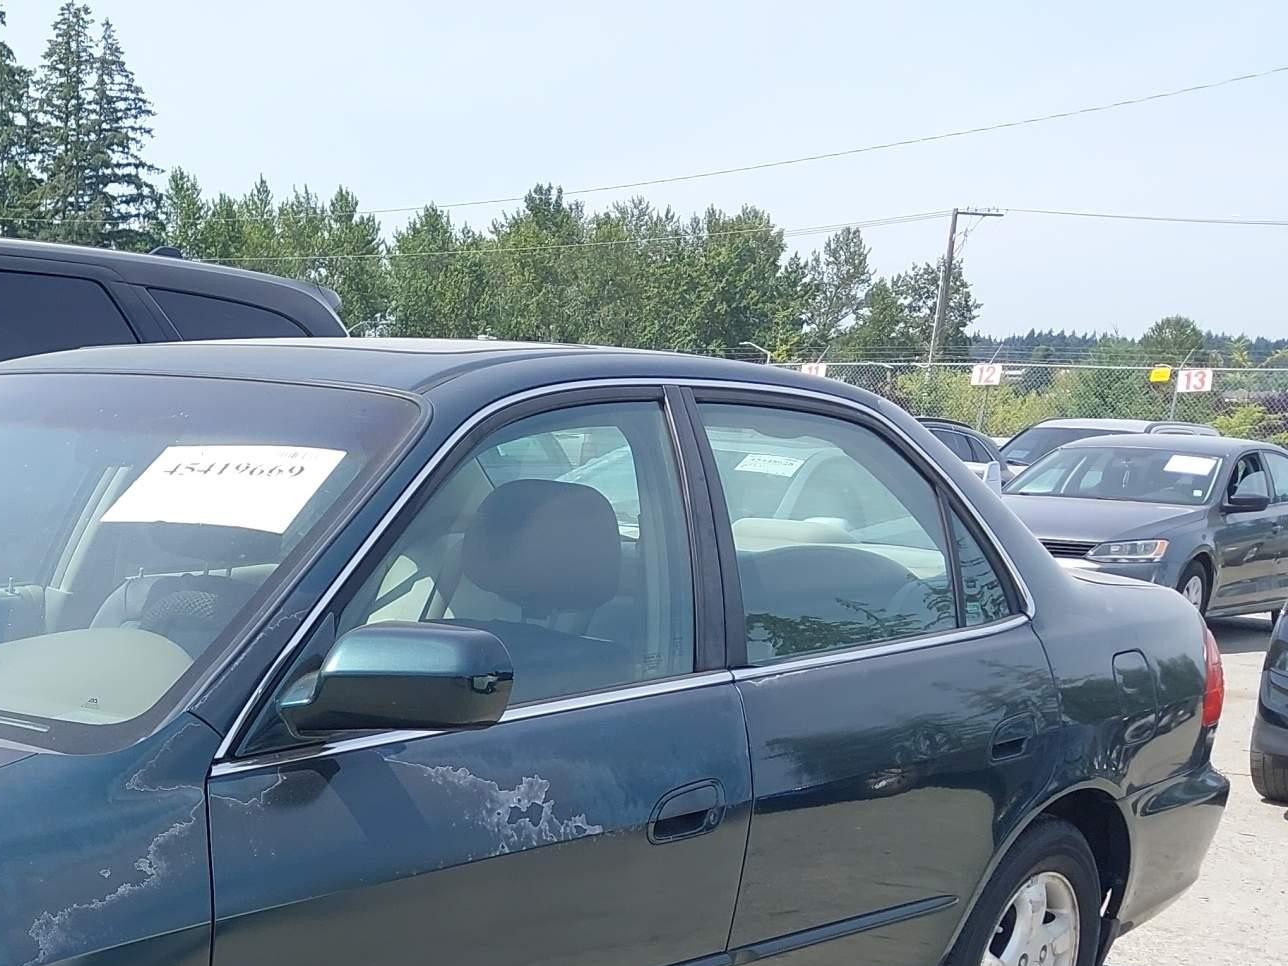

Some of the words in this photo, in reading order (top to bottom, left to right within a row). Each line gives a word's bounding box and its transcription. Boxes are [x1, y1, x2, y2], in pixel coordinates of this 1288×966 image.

[977, 366, 996, 383] 12
[1184, 371, 1207, 390] 13
[163, 462, 306, 478] 45419669
